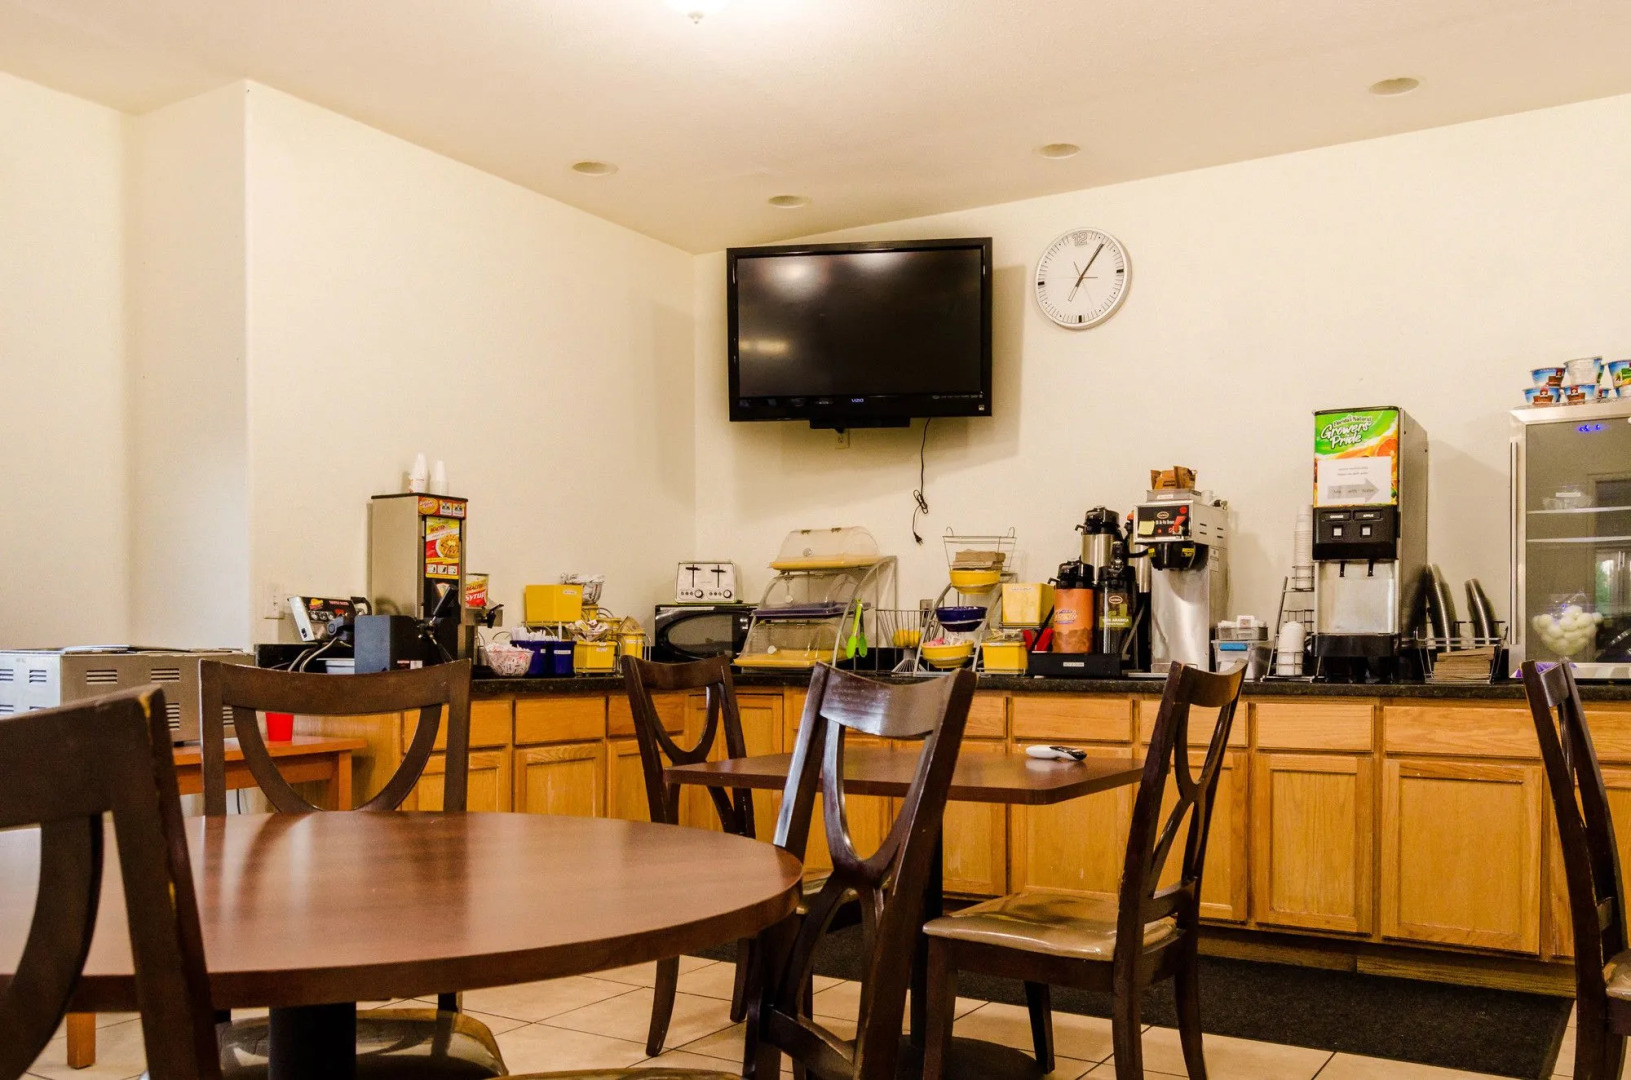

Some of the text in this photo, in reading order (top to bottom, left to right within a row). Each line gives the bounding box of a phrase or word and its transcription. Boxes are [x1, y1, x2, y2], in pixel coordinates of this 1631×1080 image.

[1071, 231, 1088, 247] 12
[1333, 415, 1352, 427] Florida's
[1330, 432, 1362, 448] Pride
